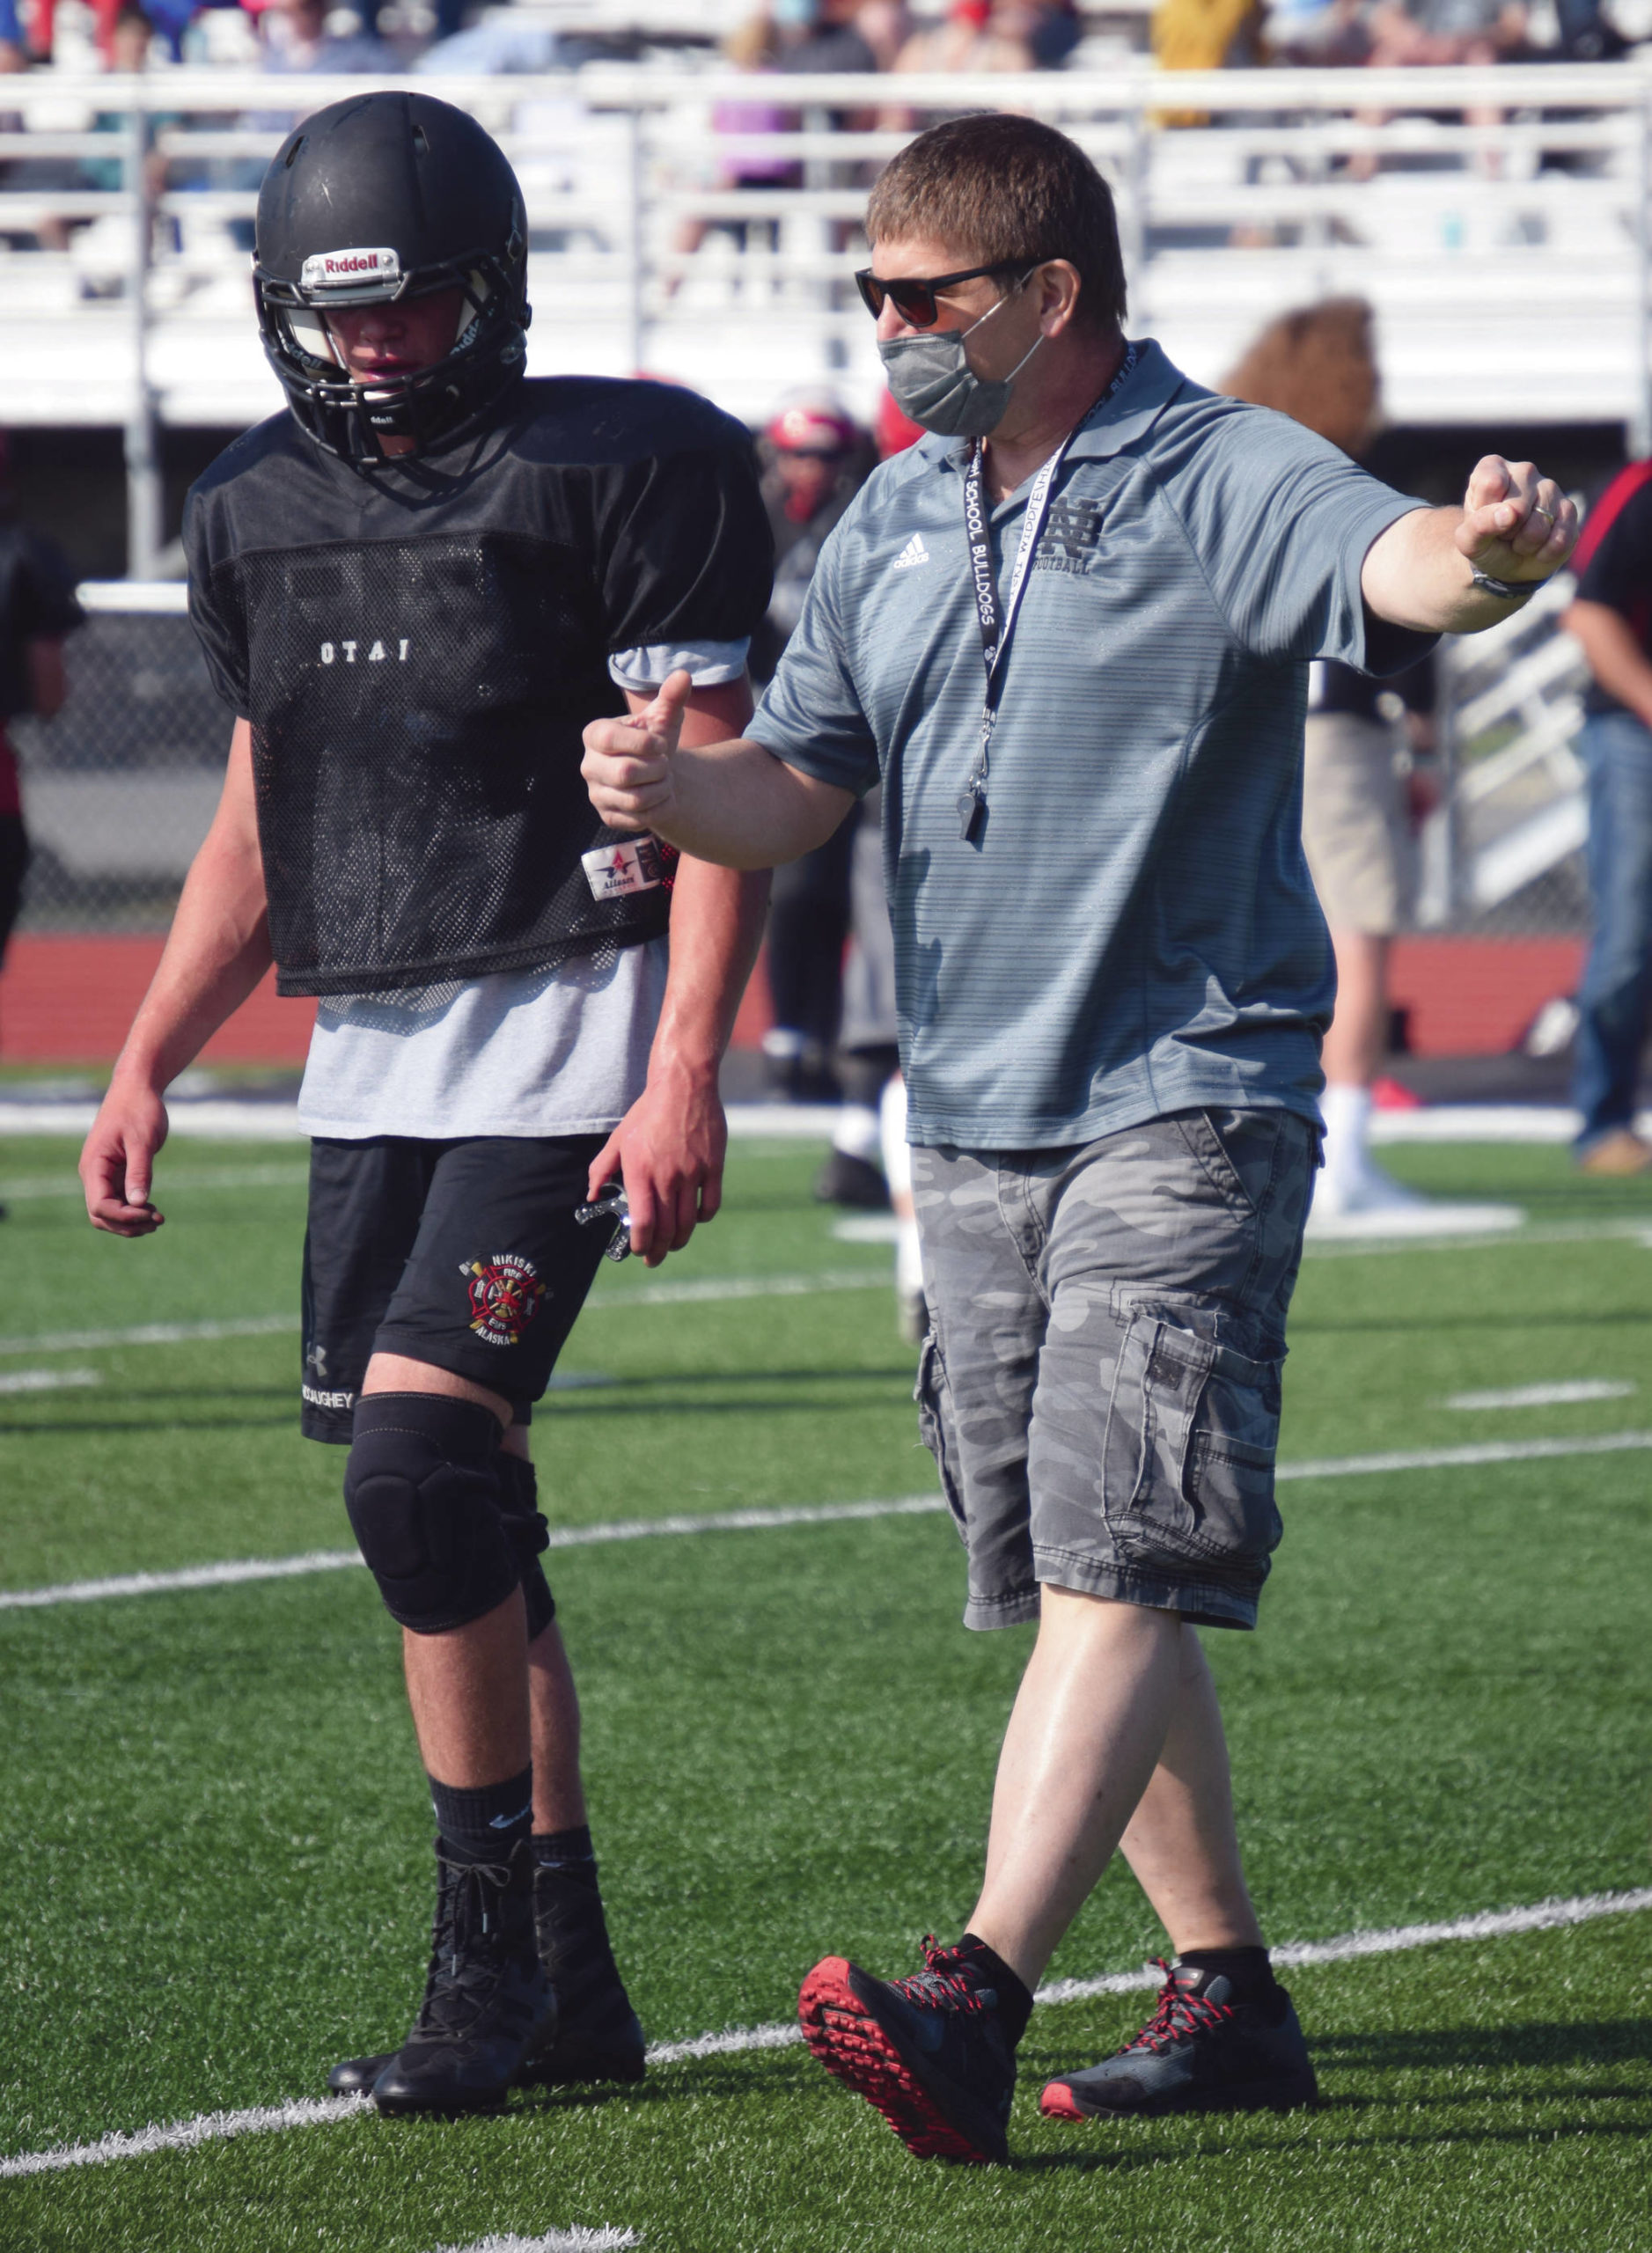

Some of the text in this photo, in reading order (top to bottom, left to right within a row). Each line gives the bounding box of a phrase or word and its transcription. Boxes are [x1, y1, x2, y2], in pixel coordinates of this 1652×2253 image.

[324, 253, 378, 274] Riddell
[966, 480, 983, 541] SCHOOL
[893, 552, 929, 569] adidas
[971, 544, 995, 626] BULLDOGS
[320, 639, 409, 664] OTAI
[491, 1253, 537, 1278] NIKISKI
[503, 1267, 523, 1281] FIRE
[474, 1325, 511, 1346] ALASKA
